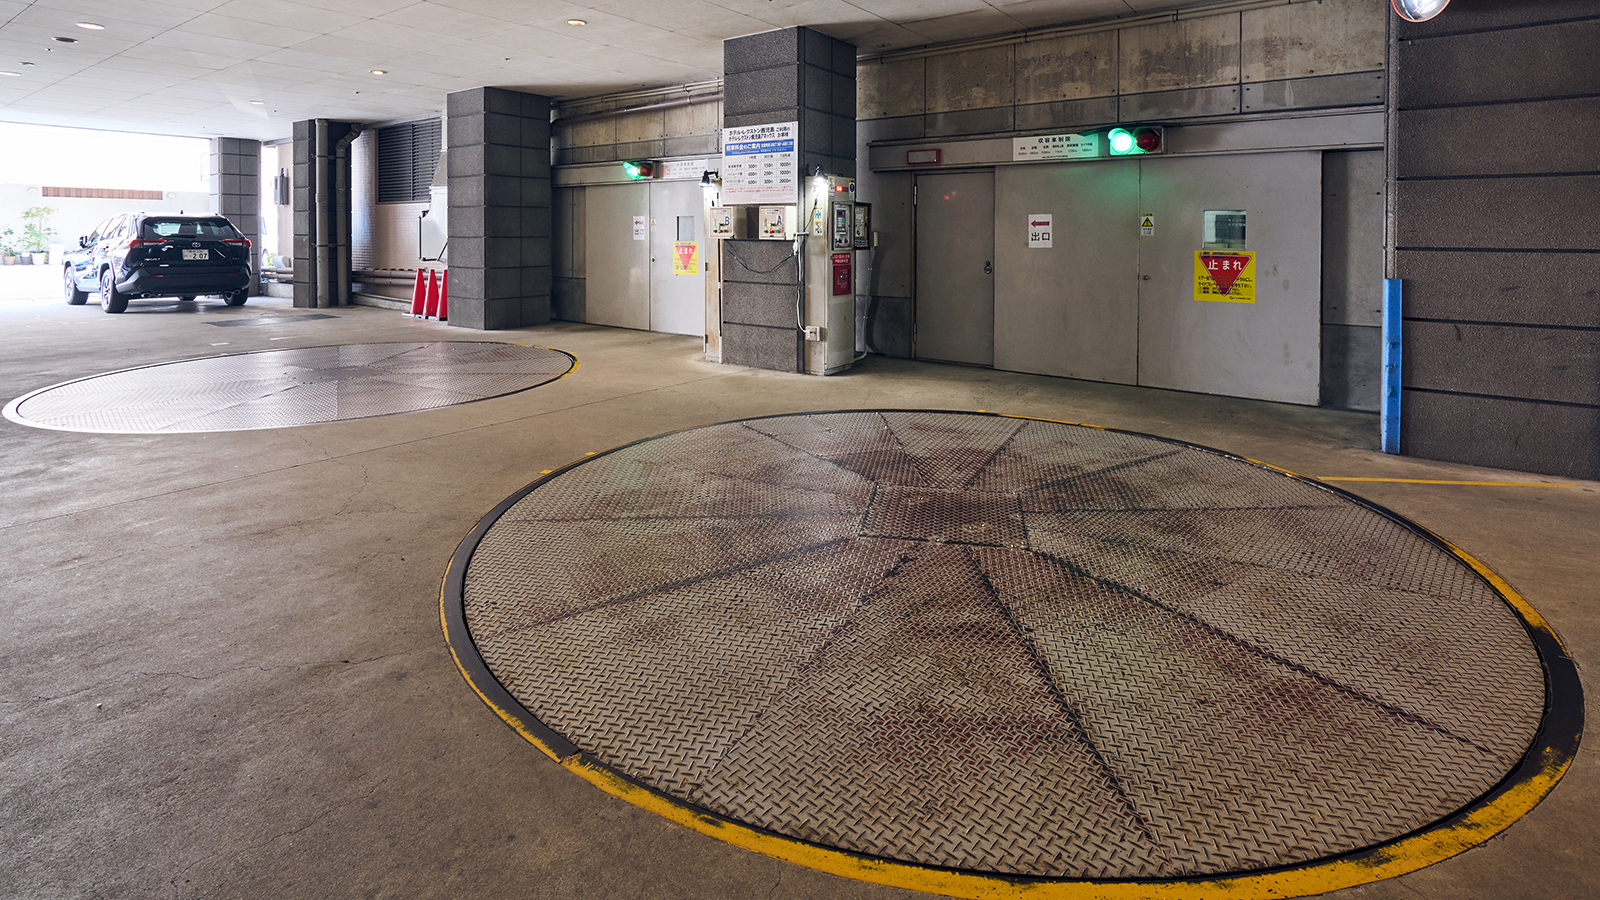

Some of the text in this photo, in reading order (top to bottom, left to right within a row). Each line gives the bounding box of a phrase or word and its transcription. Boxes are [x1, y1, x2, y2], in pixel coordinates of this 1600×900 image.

[725, 216, 730, 226] B
[776, 215, 782, 225] A
[1031, 232, 1050, 241] 出口
[1208, 260, 1242, 270] 止まれ
